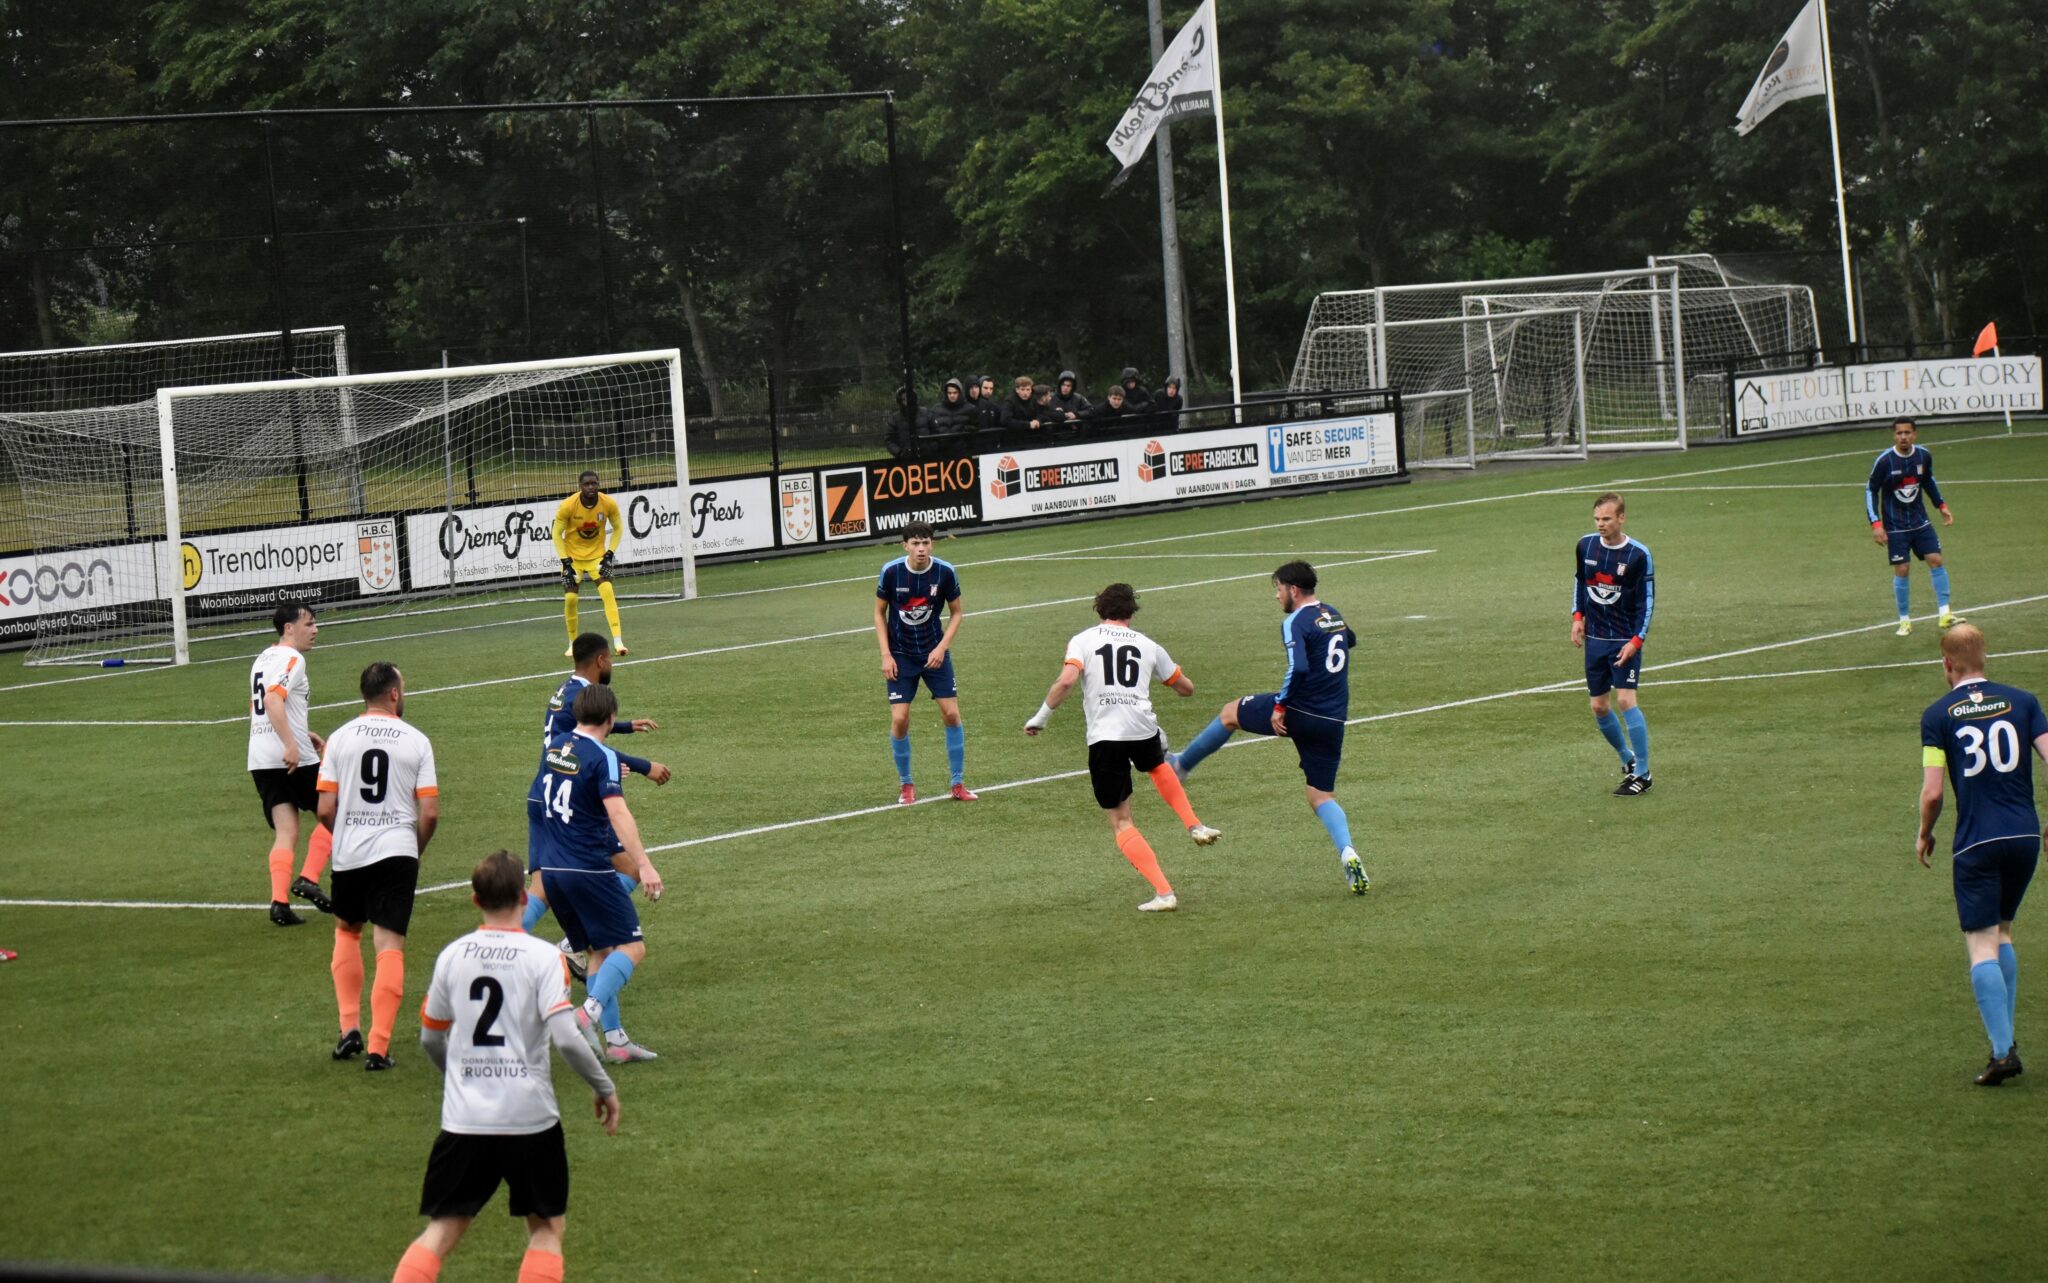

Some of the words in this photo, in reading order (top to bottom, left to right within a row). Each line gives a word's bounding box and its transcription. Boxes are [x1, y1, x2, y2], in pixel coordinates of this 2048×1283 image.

[1903, 362, 2036, 390] FACTORY
[1771, 408, 1813, 426] STYLING
[1814, 402, 1864, 421] CENTER
[1868, 401, 1880, 415] &
[1885, 395, 1960, 415] LUXURY
[1967, 393, 2039, 409] OUTLET
[1286, 431, 1312, 447] SAFE
[1314, 430, 1322, 445] &
[1324, 426, 1365, 443] SECURE
[1287, 450, 1304, 464] VAN
[1305, 448, 1322, 461] DER
[1325, 446, 1351, 460] MEER
[784, 480, 810, 491] H.B.C.
[873, 458, 975, 500] ZOBEKO
[1175, 487, 1187, 496] UW
[1188, 482, 1221, 494] AANBOUW
[1222, 481, 1229, 490] IN
[1235, 478, 1256, 489] DAGEN
[1031, 503, 1043, 512] UW
[1044, 498, 1079, 510] AANBOUW
[1080, 497, 1088, 506] IN
[1088, 496, 1093, 506] 5
[1093, 494, 1117, 505] DAGEN
[628, 495, 682, 540] Crèm
[690, 491, 744, 538] Fresh
[829, 519, 866, 536] ZOBEKO
[875, 504, 977, 531] WWWZOBEKO.NL
[361, 525, 391, 536] H.B.C.
[439, 514, 507, 560] Crème
[206, 541, 344, 575] Trendhopper
[633, 546, 651, 557] Men's
[652, 544, 675, 555] fashion
[702, 539, 721, 549] Books
[724, 537, 745, 547] Coffee
[464, 565, 489, 576] fashion
[494, 563, 513, 573] Shoes
[518, 559, 538, 570] Books
[200, 592, 275, 609] Woonboulevard
[278, 586, 322, 601] Cruquius
[0, 614, 67, 635] oonboulevard
[71, 609, 117, 626] Cruquius
[1099, 627, 1137, 638] Pronto
[1095, 643, 1142, 688] 16
[1325, 634, 1346, 674] 6
[1629, 669, 1636, 679] 8
[253, 671, 266, 716] 5
[1953, 700, 2006, 717] Oliehoorn
[356, 724, 402, 739] Pronto
[1955, 720, 2020, 777] 30
[360, 749, 389, 804] 9
[542, 773, 574, 824] 14
[464, 941, 518, 961] Pronto
[469, 976, 505, 1047] 2
